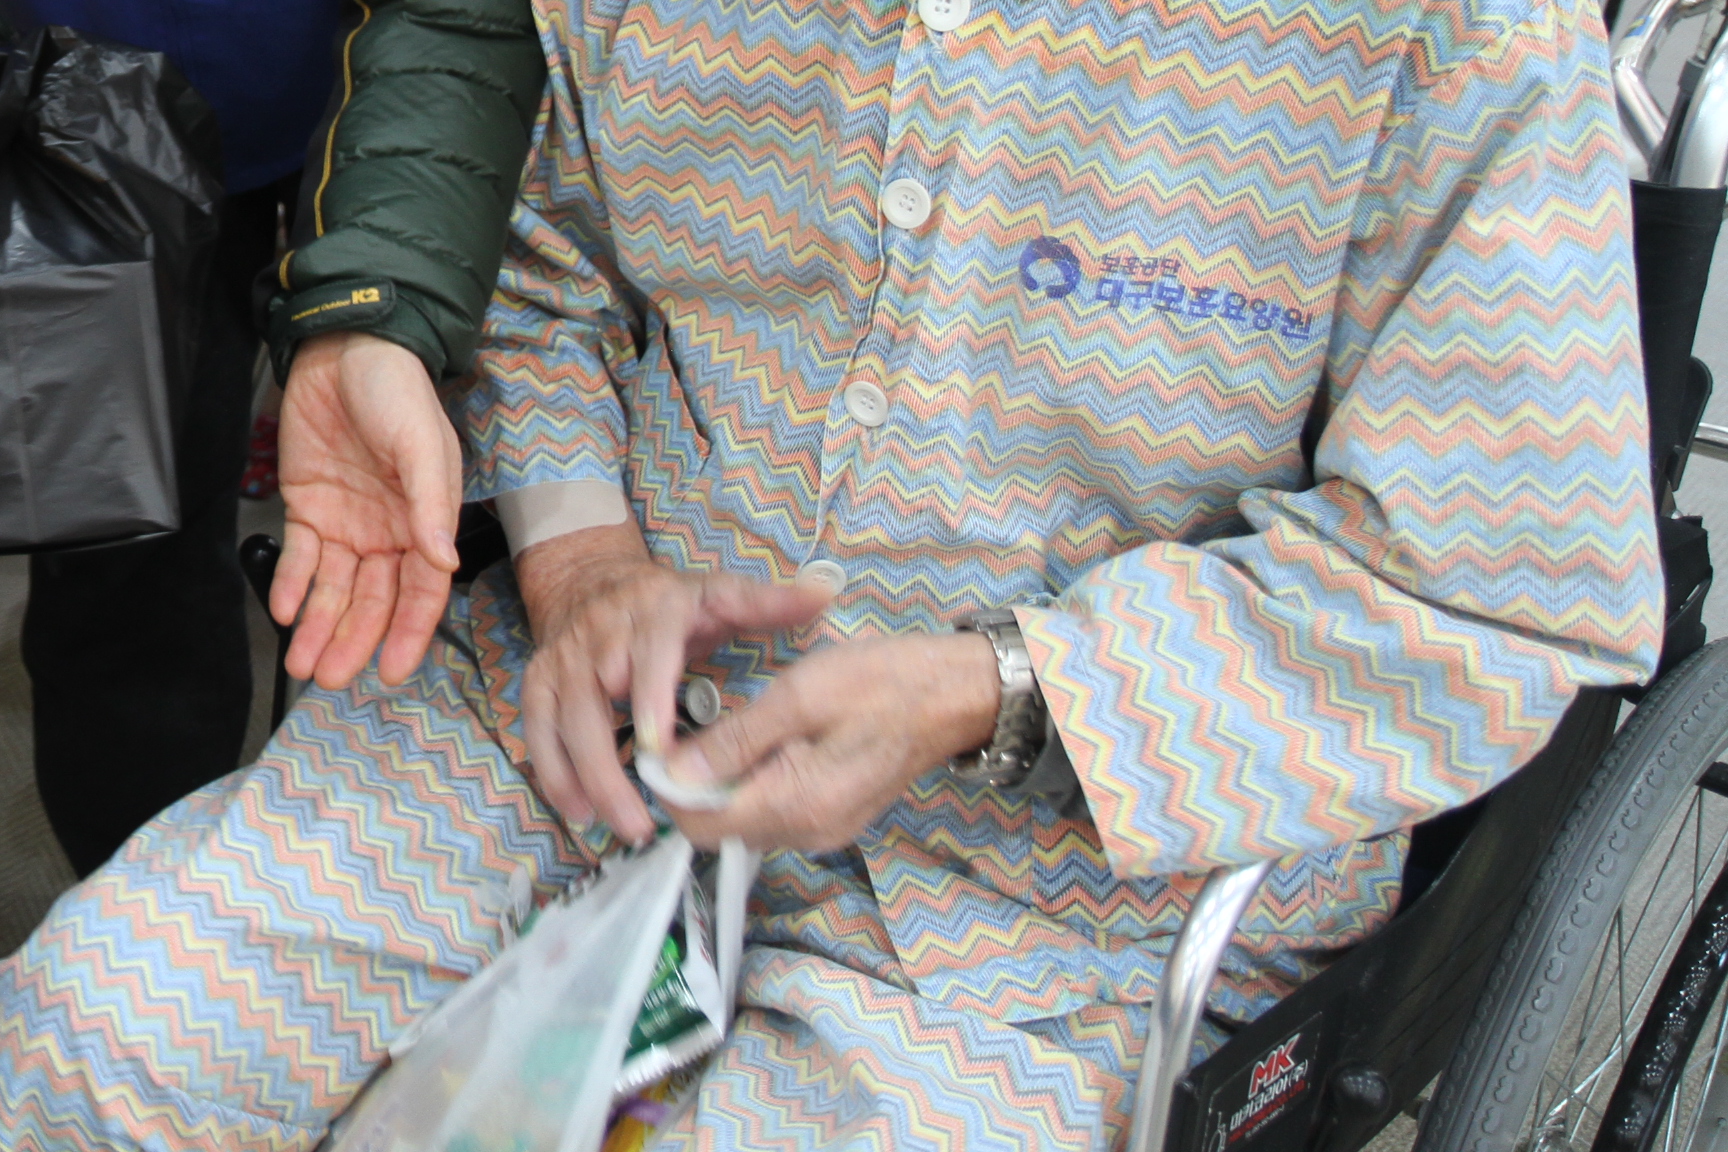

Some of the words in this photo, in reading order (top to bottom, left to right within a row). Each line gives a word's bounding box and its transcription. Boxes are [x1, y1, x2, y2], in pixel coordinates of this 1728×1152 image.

[1099, 252, 1181, 278] 보훈공단
[351, 286, 381, 305] K2
[1094, 278, 1314, 341] 대구보훈요양원
[1247, 1032, 1301, 1100] MK
